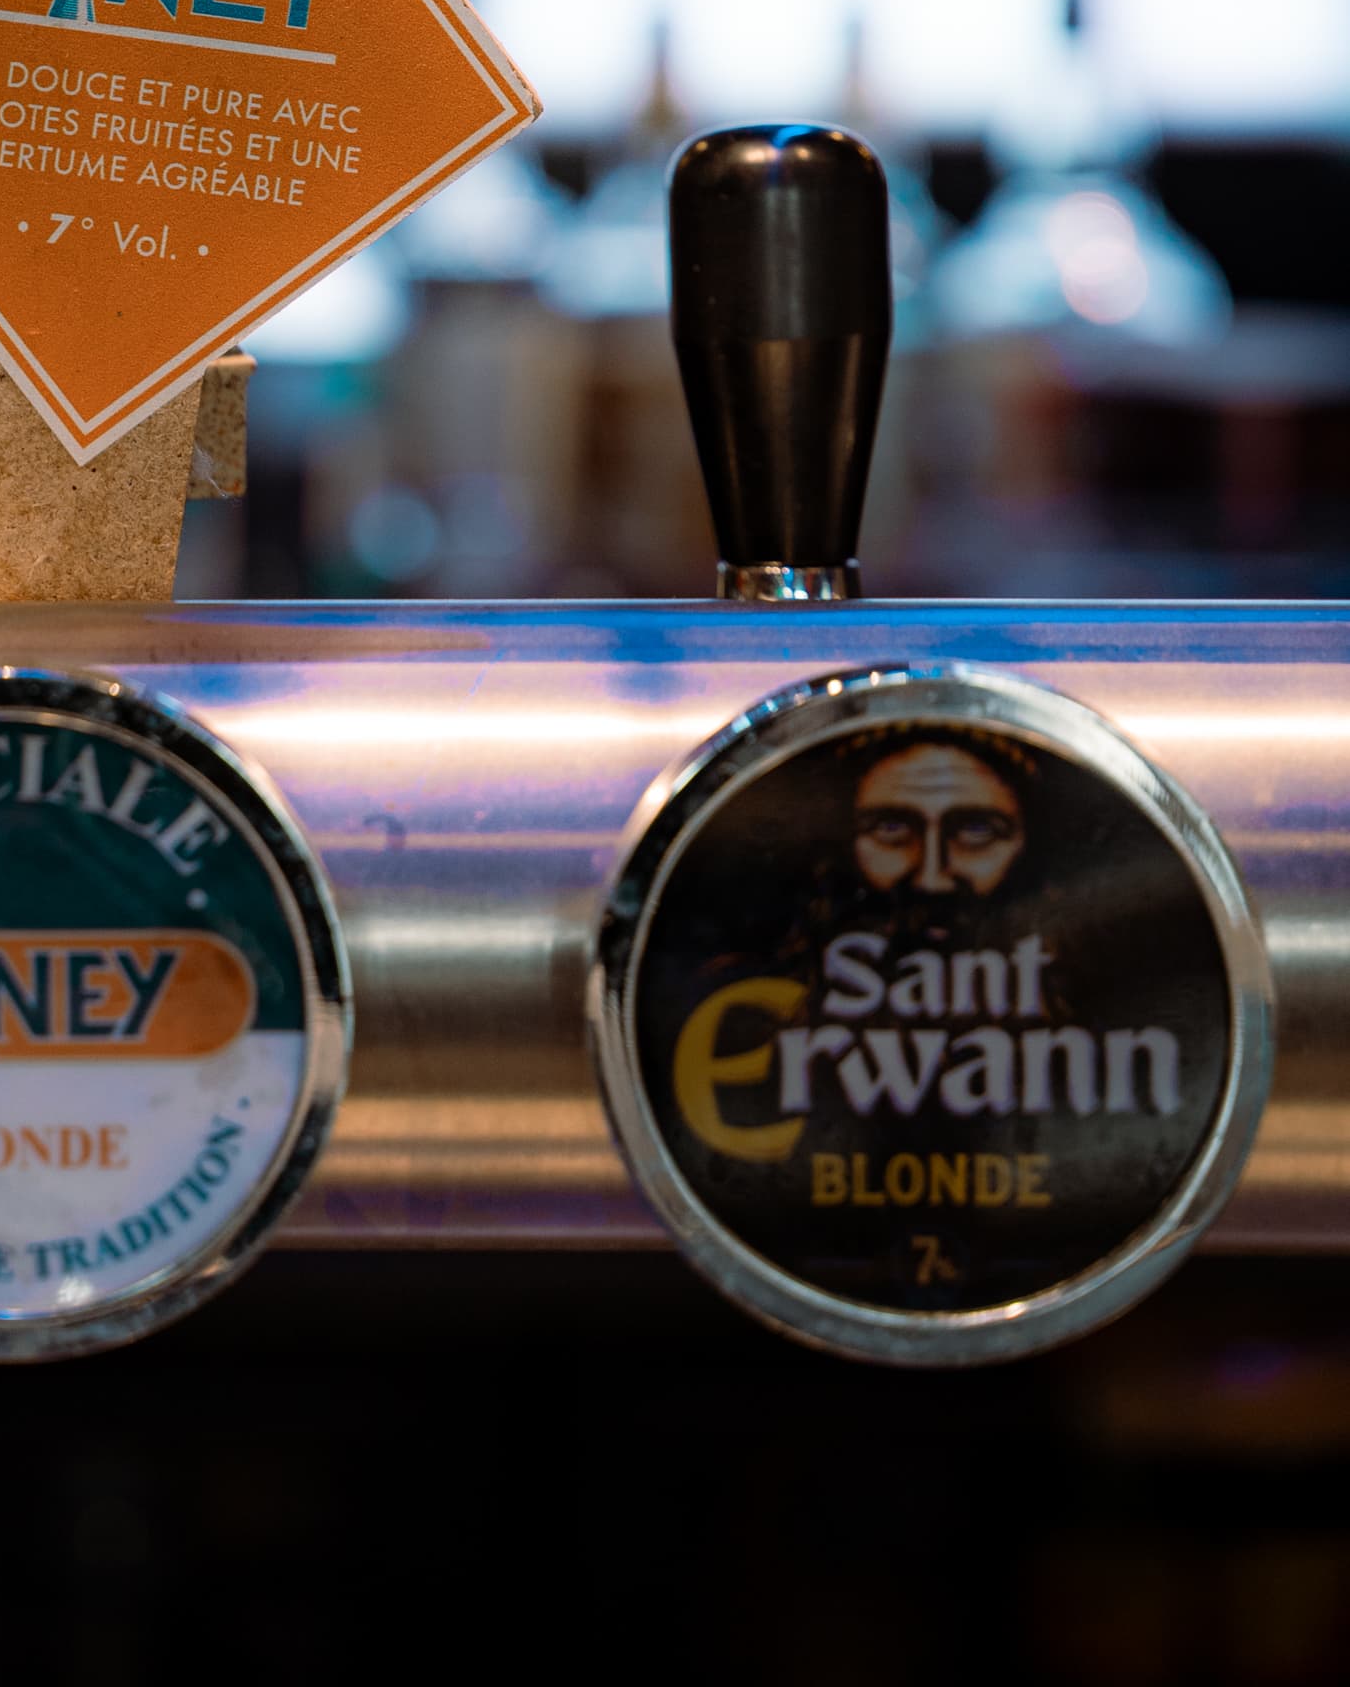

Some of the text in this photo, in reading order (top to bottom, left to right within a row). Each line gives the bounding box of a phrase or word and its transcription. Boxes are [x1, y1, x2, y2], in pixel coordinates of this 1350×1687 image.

[7, 61, 127, 103] DOUCE
[138, 79, 173, 107] ET
[184, 85, 263, 121] PURE
[273, 97, 361, 134] AVEC
[91, 115, 235, 158] FRUITÉES
[246, 134, 281, 162] ET
[292, 140, 361, 174] UNE
[137, 161, 306, 206] AGRÉABLE
[46, 213, 177, 261] 7° Vol.
[822, 931, 1053, 1018] Sant
[672, 976, 1181, 1163] Erwann
[26, 1116, 246, 1279] TRADITION
[810, 1152, 1051, 1207] BLONDE
